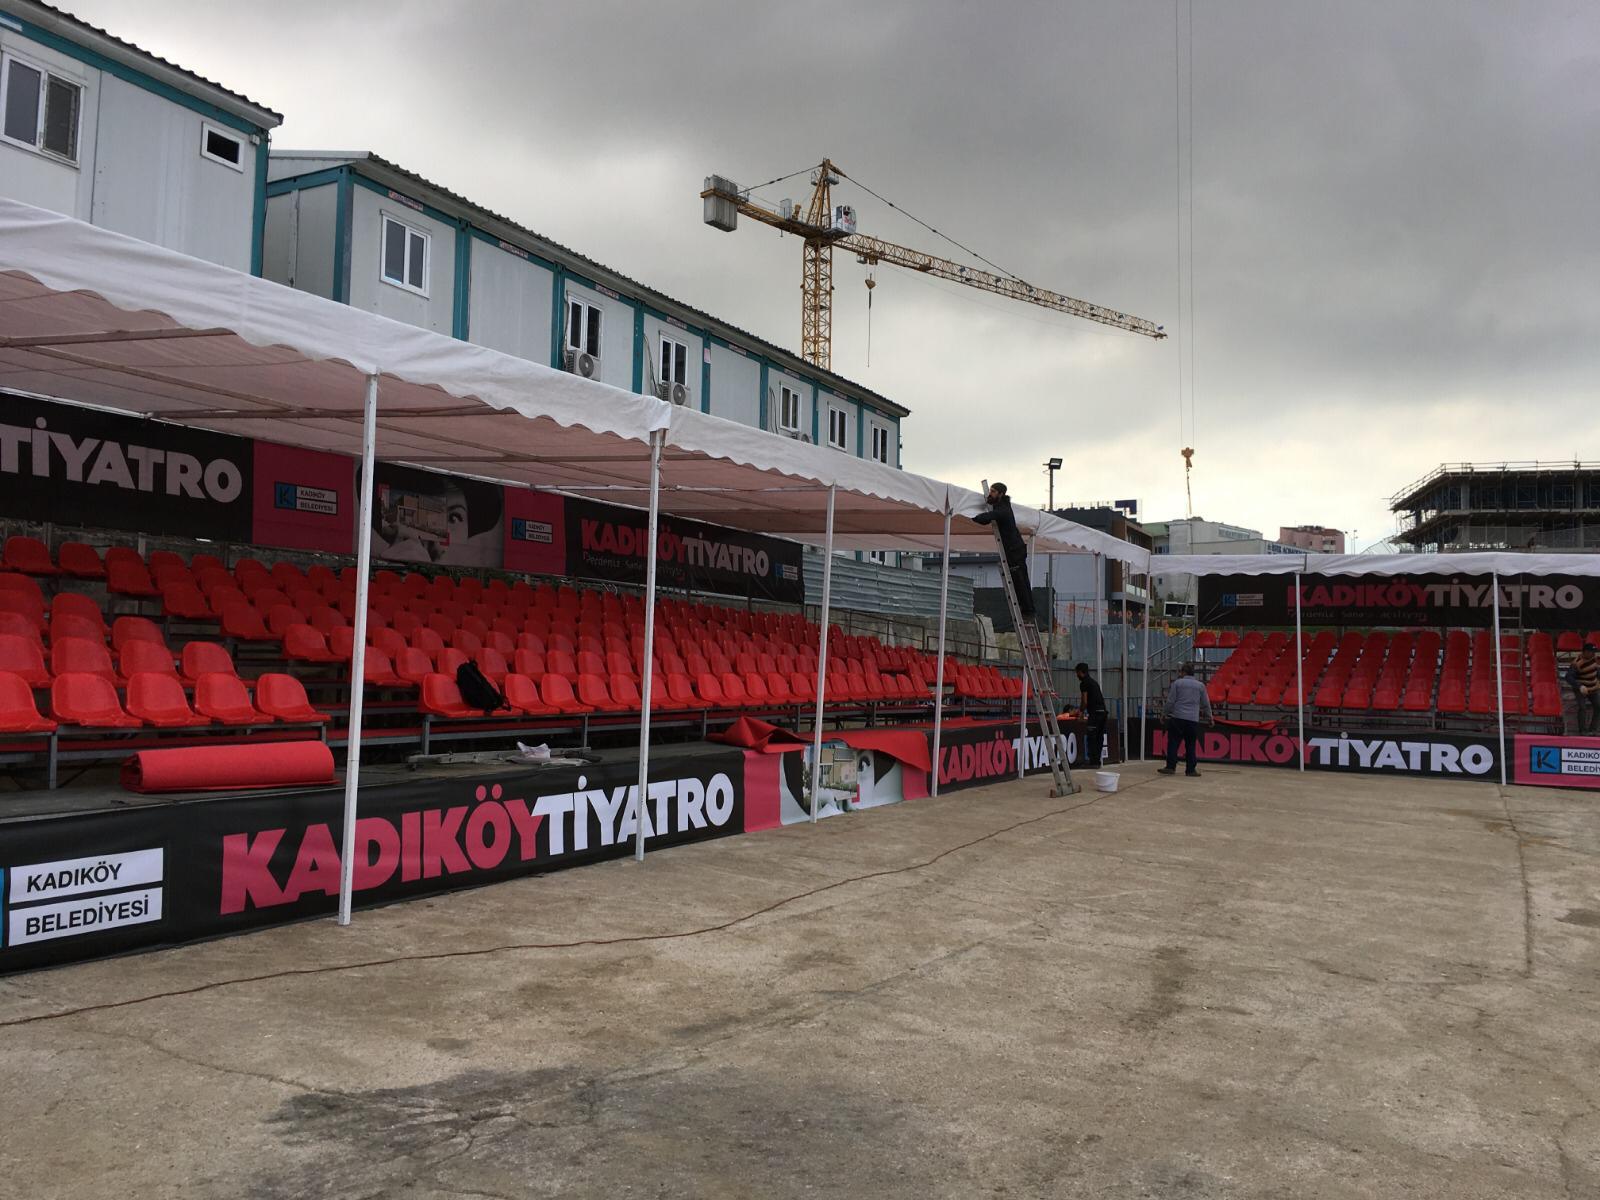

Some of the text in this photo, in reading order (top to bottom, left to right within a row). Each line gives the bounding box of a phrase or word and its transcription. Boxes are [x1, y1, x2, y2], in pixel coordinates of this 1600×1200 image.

[0, 416, 242, 503] TİYATRO
[1567, 763, 1600, 773] BELEDİ
[27, 861, 122, 893] KADIKÖY
[26, 894, 149, 936] BELEDİYESİ
